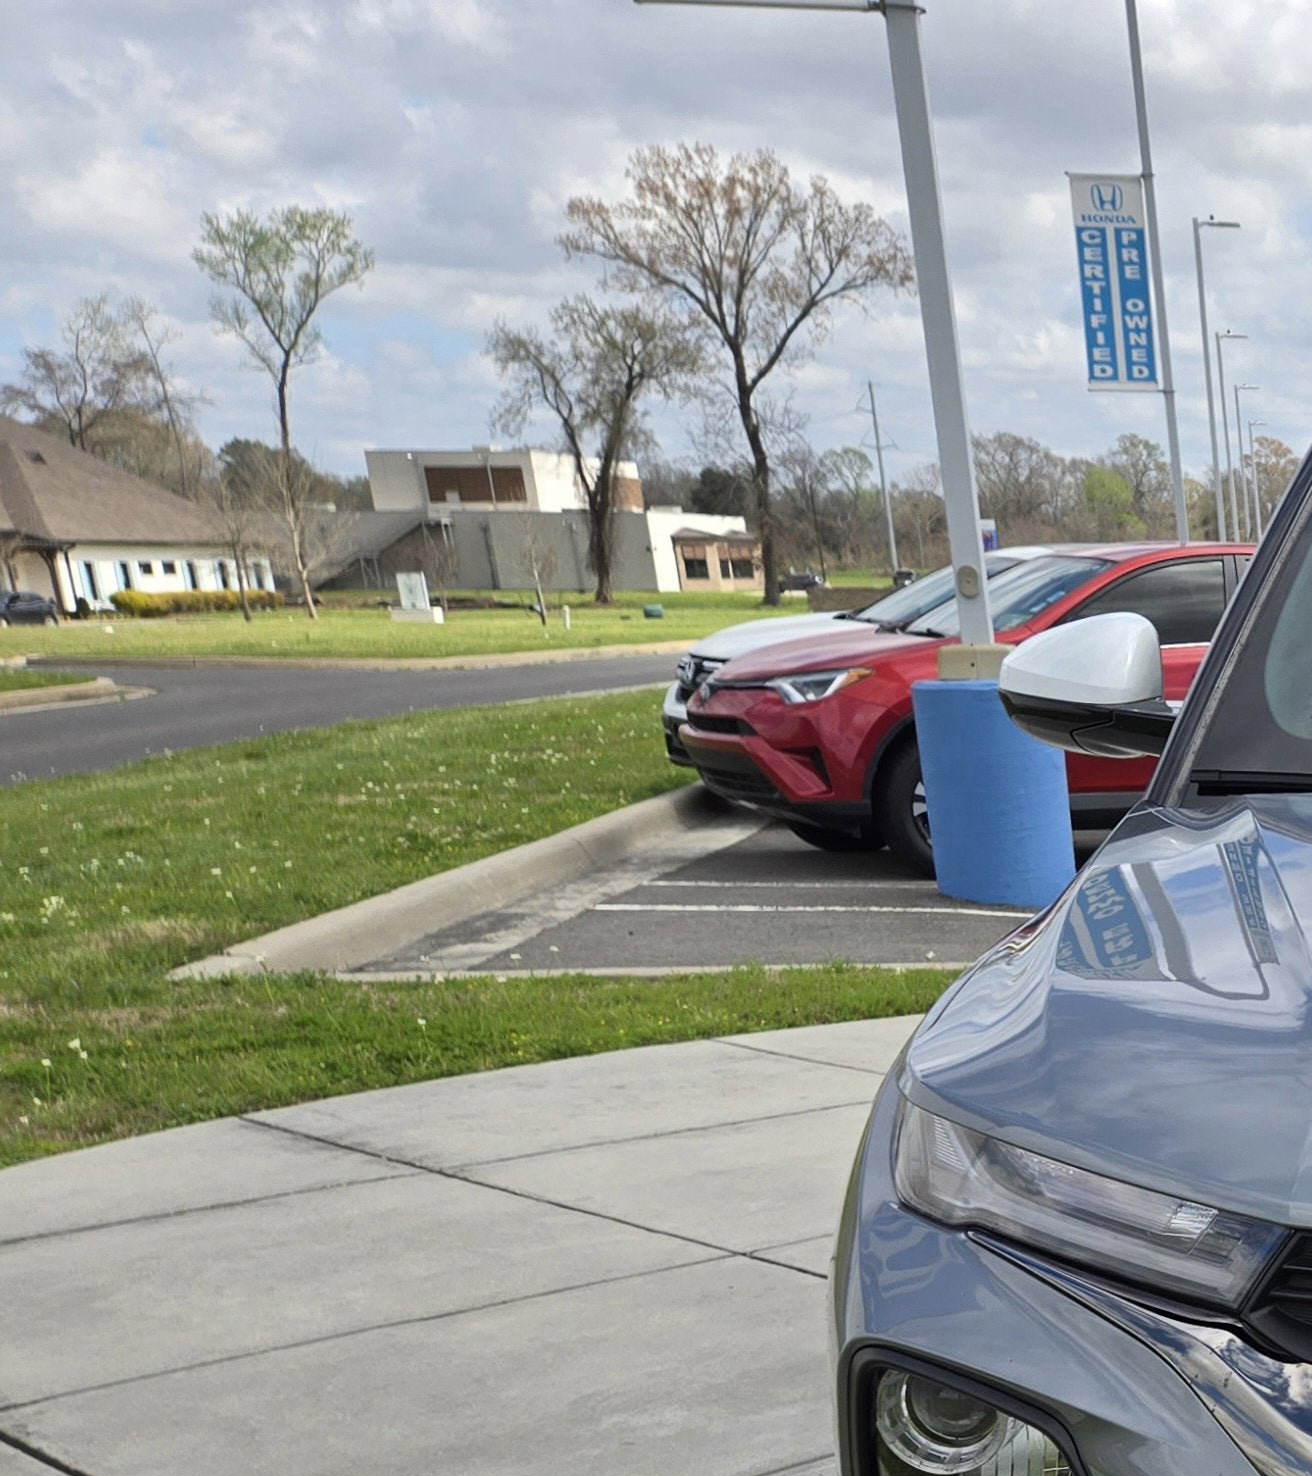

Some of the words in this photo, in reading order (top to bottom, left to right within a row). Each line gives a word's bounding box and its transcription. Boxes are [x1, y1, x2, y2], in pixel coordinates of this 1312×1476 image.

[1081, 214, 1136, 223] HONDA
[1121, 230, 1140, 280] PRE
[1081, 229, 1115, 378] CERTIFIED
[1125, 298, 1149, 378] OWNED
